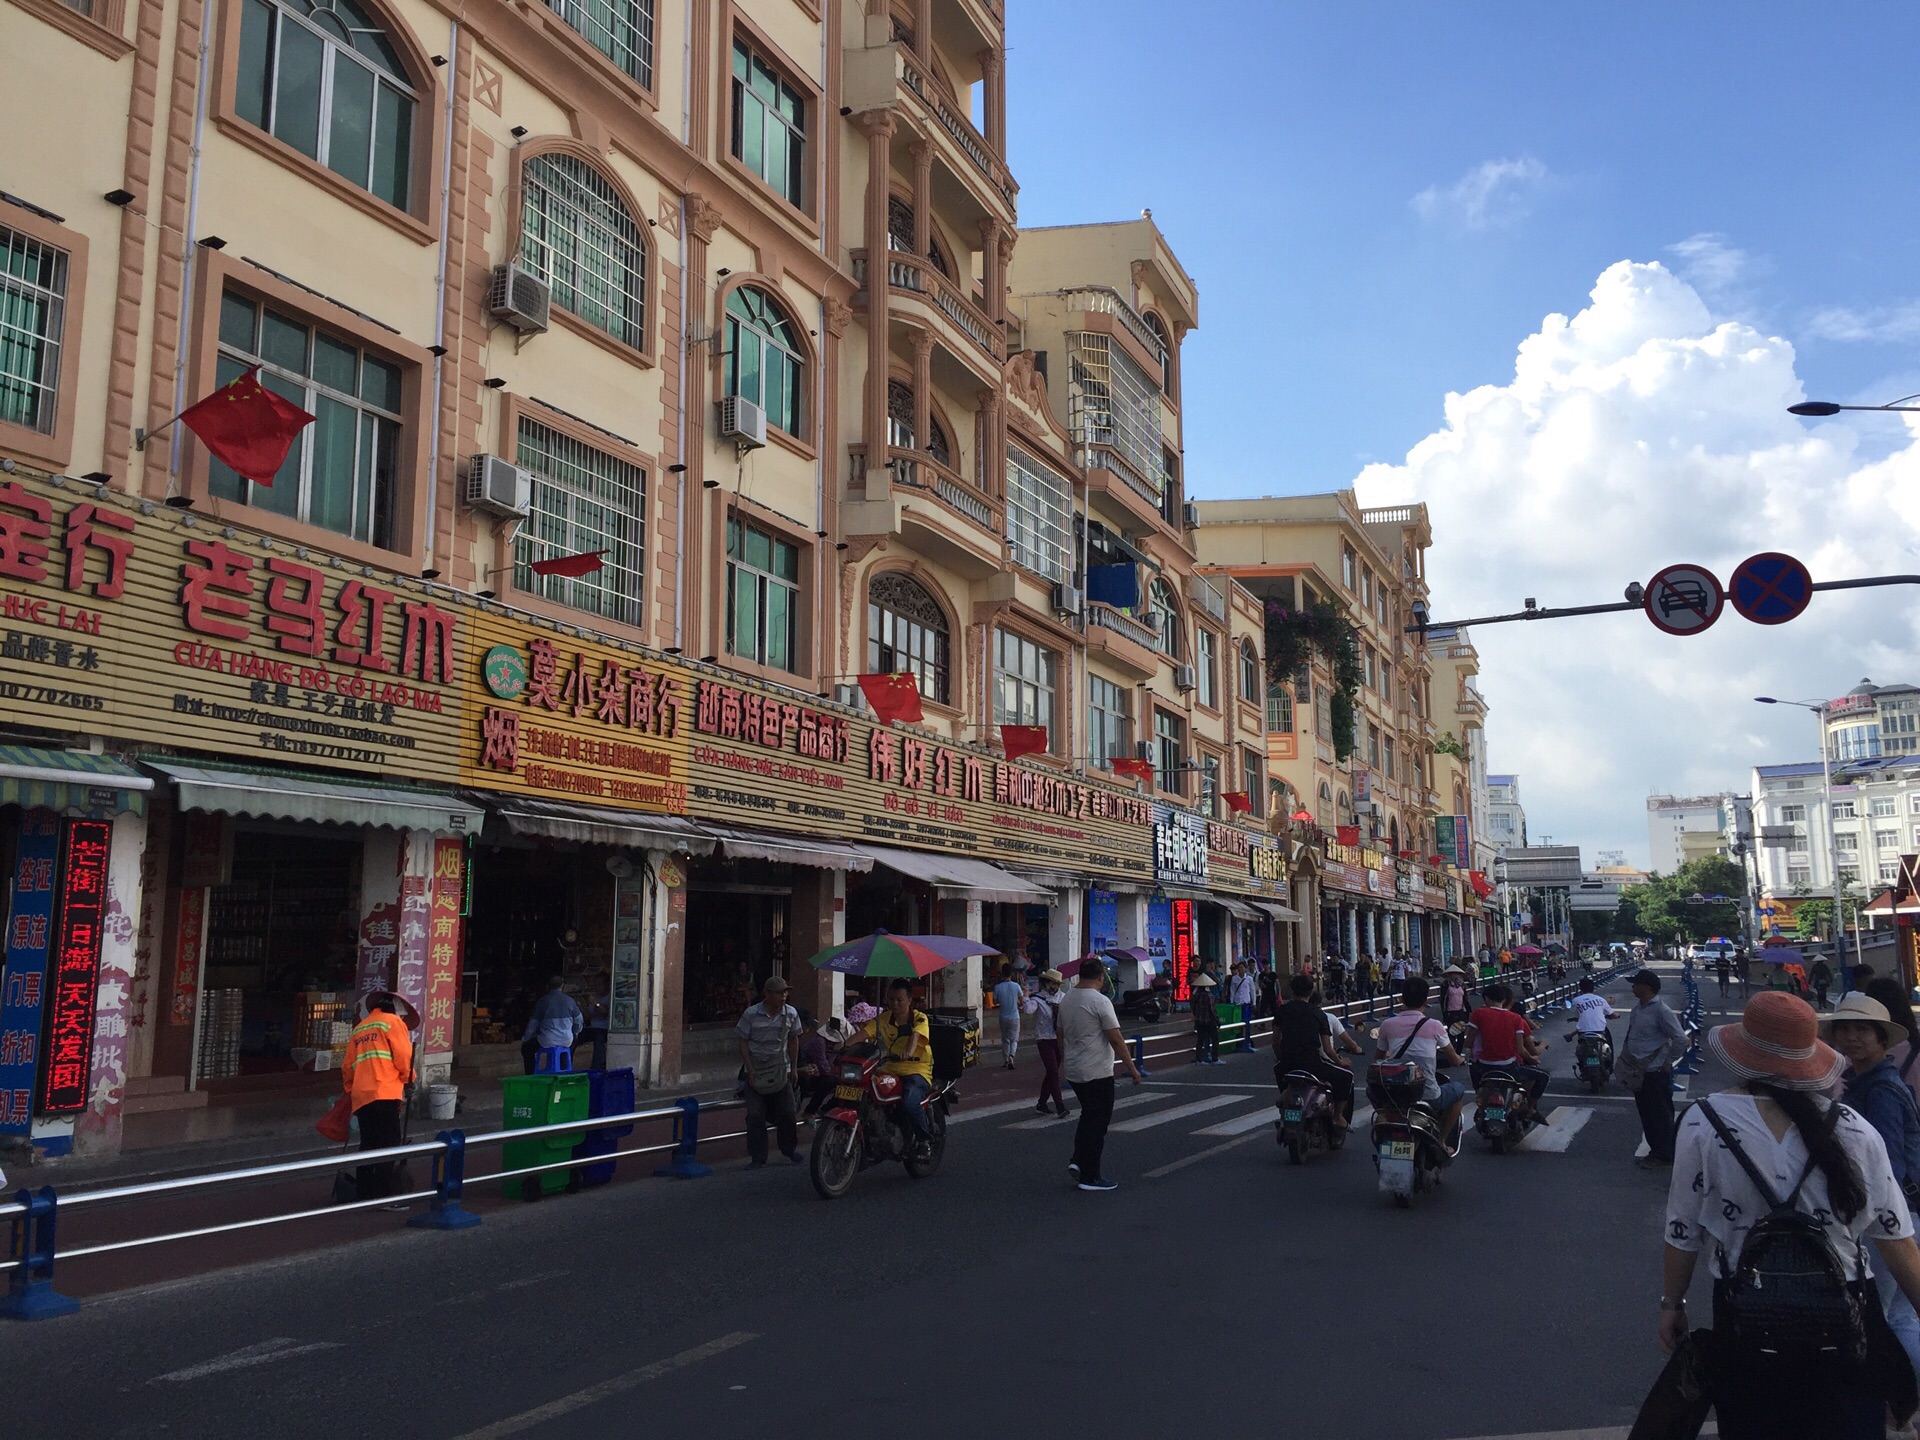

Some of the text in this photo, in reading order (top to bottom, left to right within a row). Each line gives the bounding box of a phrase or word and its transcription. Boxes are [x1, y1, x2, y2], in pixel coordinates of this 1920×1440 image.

[58, 605, 102, 635] LAI
[178, 540, 457, 684] 老马红木
[2, 630, 99, 671] 品牌香水
[174, 639, 223, 673] CỬA
[230, 650, 293, 684] HÀNG
[526, 638, 684, 738] 莫小朵商行
[300, 691, 396, 726] 工艺品批发
[696, 679, 851, 763] 越南特色产品商行
[478, 706, 520, 773] 烟
[17, 857, 53, 892] 签证
[435, 845, 460, 878] 烟
[12, 913, 47, 950] 漂流
[6, 971, 43, 1009] 门票
[1576, 997, 1604, 1014] BEATLES
[1, 1029, 35, 1066] 折扣
